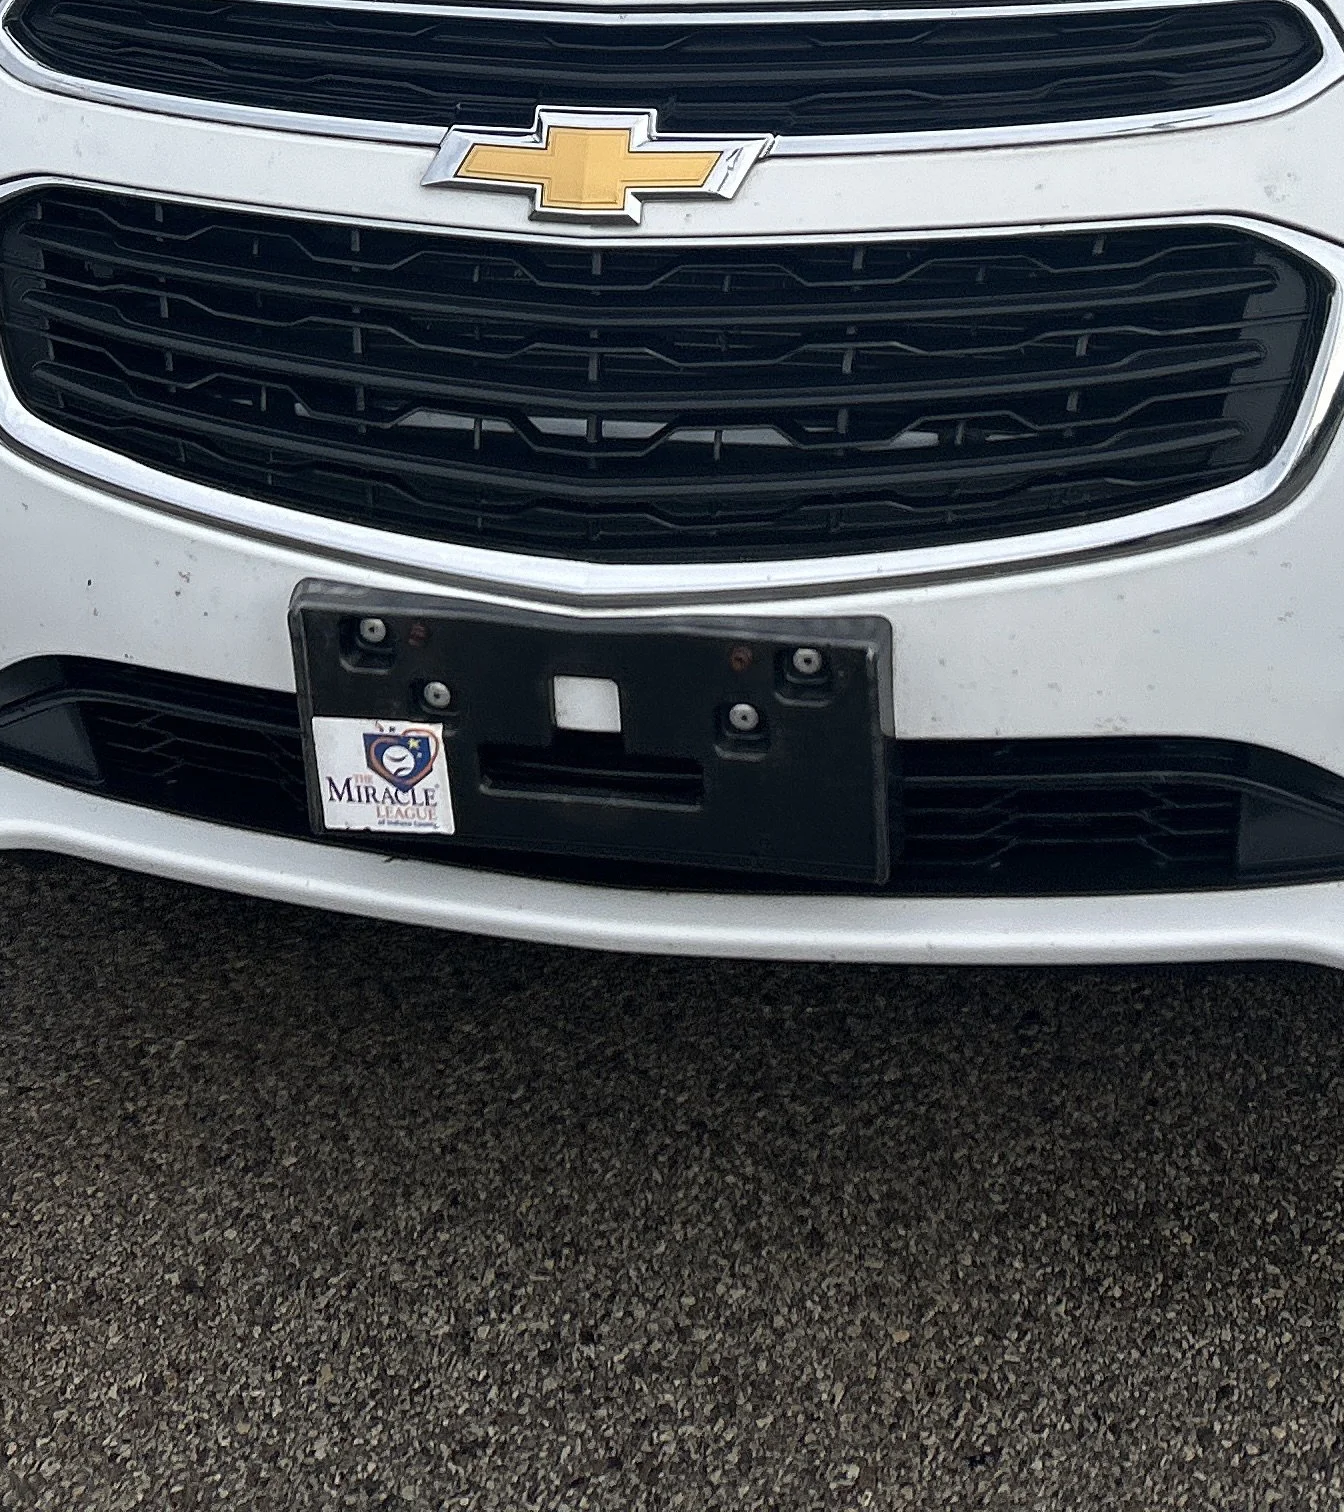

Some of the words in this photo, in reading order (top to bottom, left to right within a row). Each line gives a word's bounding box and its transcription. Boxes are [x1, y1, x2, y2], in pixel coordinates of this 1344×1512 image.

[354, 774, 374, 785] THE
[326, 776, 438, 806] MIRACLE
[376, 807, 438, 821] LEAGUE
